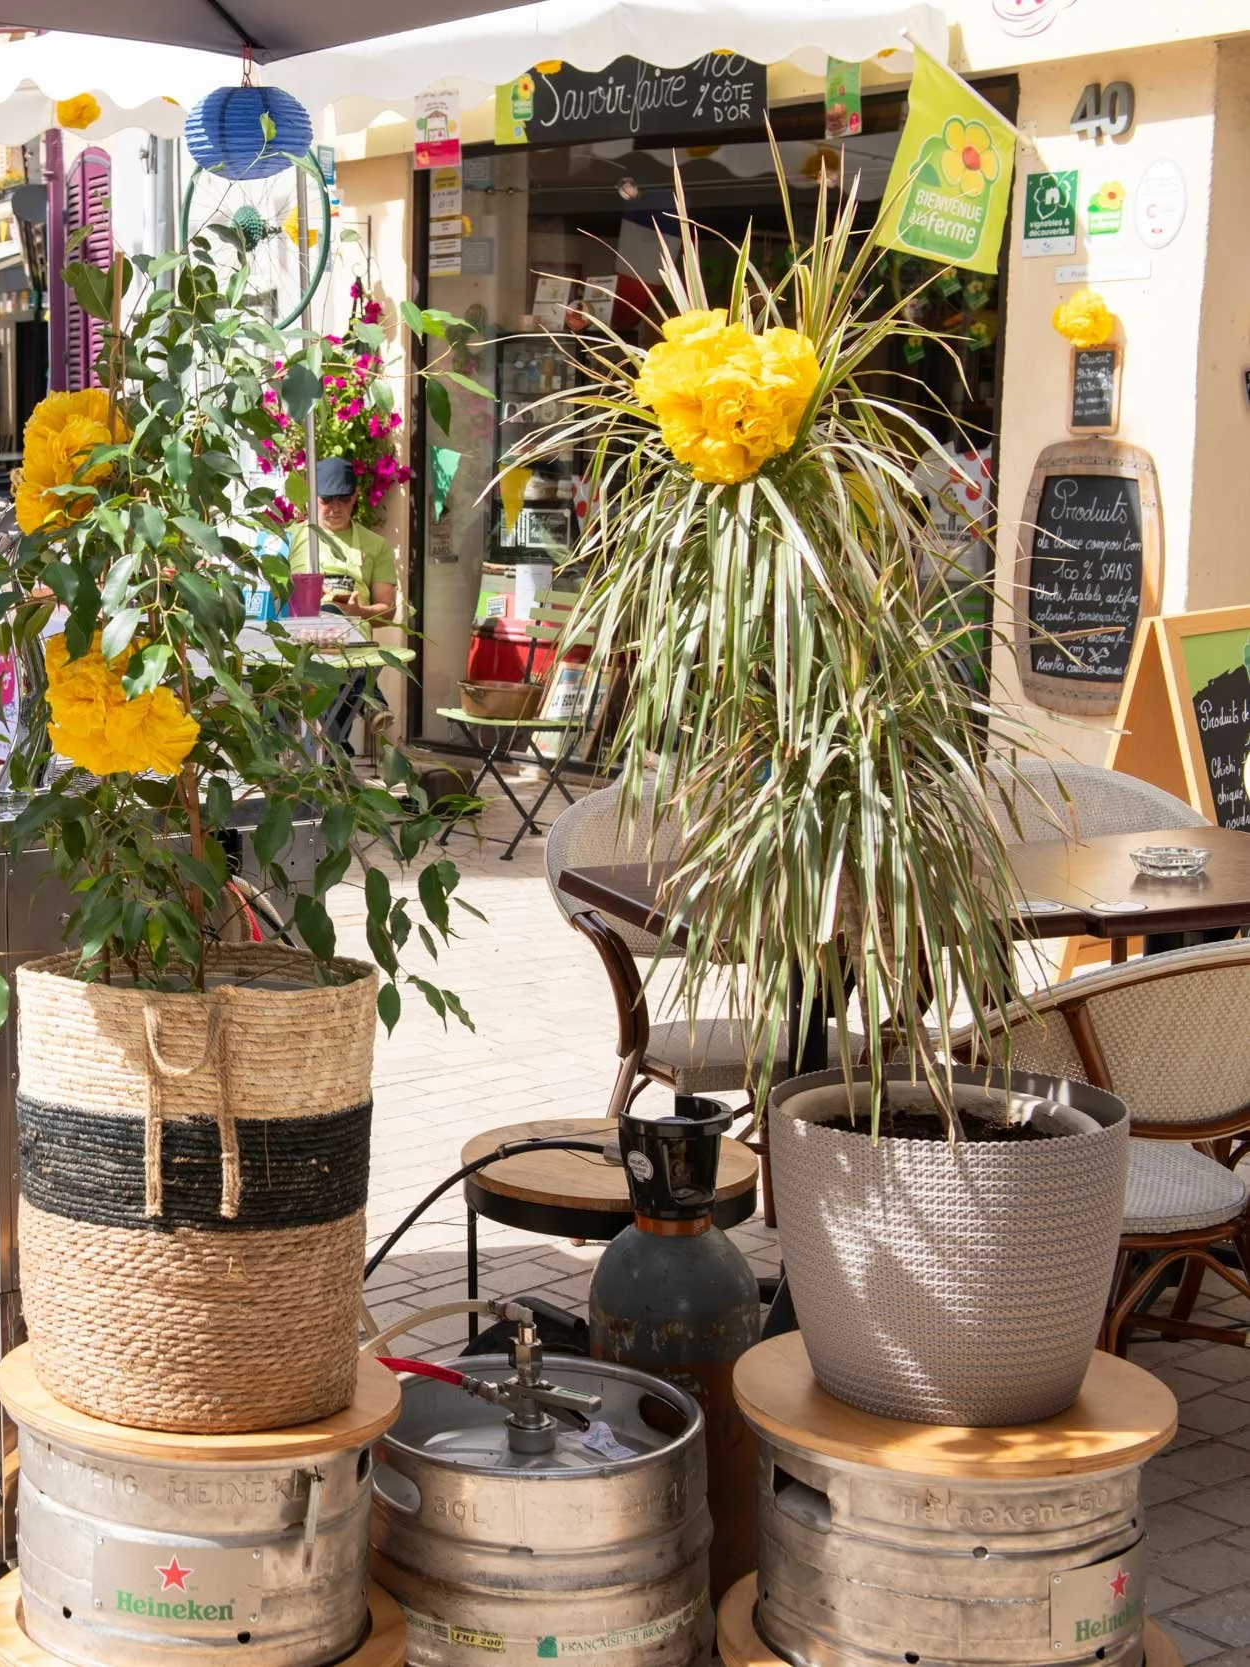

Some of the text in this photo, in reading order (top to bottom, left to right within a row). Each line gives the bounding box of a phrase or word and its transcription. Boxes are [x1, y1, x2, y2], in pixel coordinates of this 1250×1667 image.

[712, 81, 754, 103] CÔTE
[713, 103, 751, 123] D'OR
[1069, 80, 1135, 140] 40
[915, 188, 983, 222] BIENVENUE
[927, 211, 976, 245] ferme
[1051, 479, 1128, 524] Produits
[1100, 562, 1132, 581] SANS
[1200, 699, 1239, 731] Produits
[116, 1588, 234, 1622] Heineken
[561, 1634, 623, 1652] FRANÇAISE
